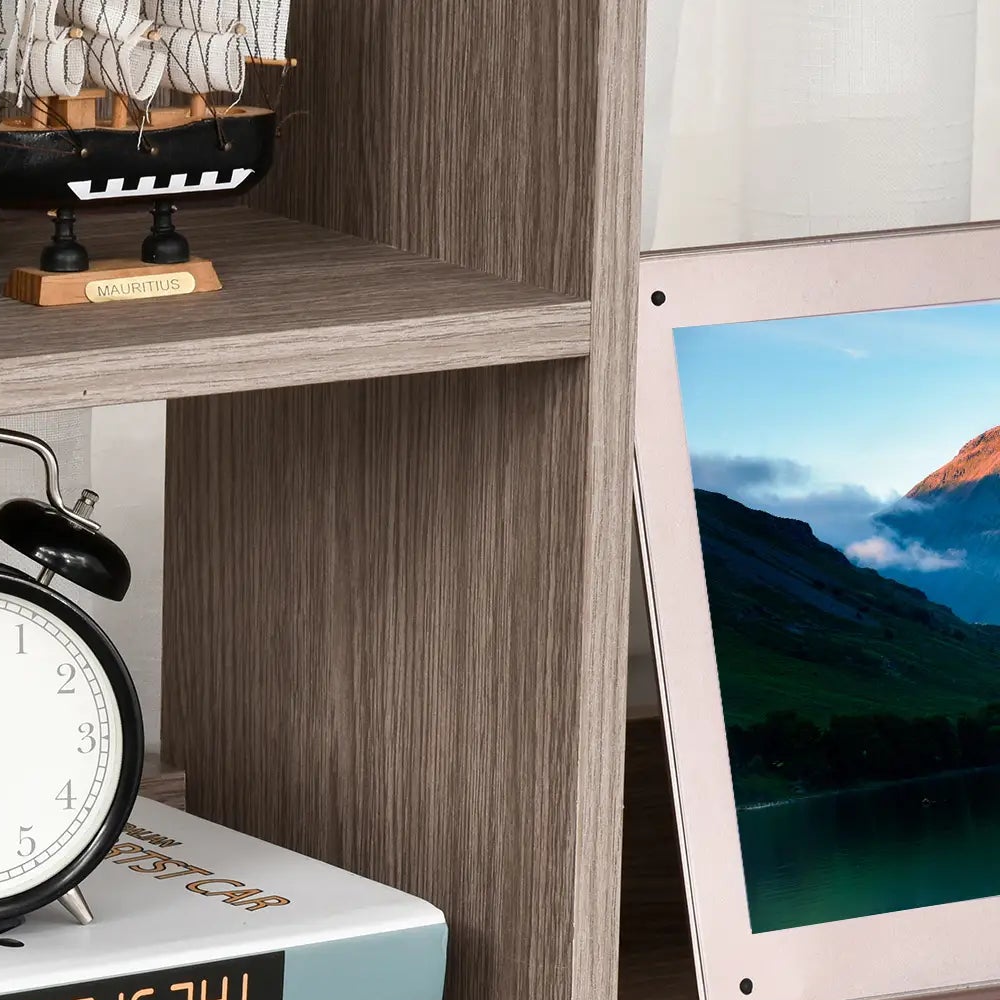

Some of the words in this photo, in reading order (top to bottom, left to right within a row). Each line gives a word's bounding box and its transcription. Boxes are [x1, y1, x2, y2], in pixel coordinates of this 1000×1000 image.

[97, 278, 181, 297] MAURITIUS
[15, 623, 28, 655] 1
[57, 663, 76, 695] 2
[77, 722, 97, 754] 3
[54, 779, 77, 810] 4
[16, 825, 37, 857] 5
[185, 878, 291, 911] CAR
